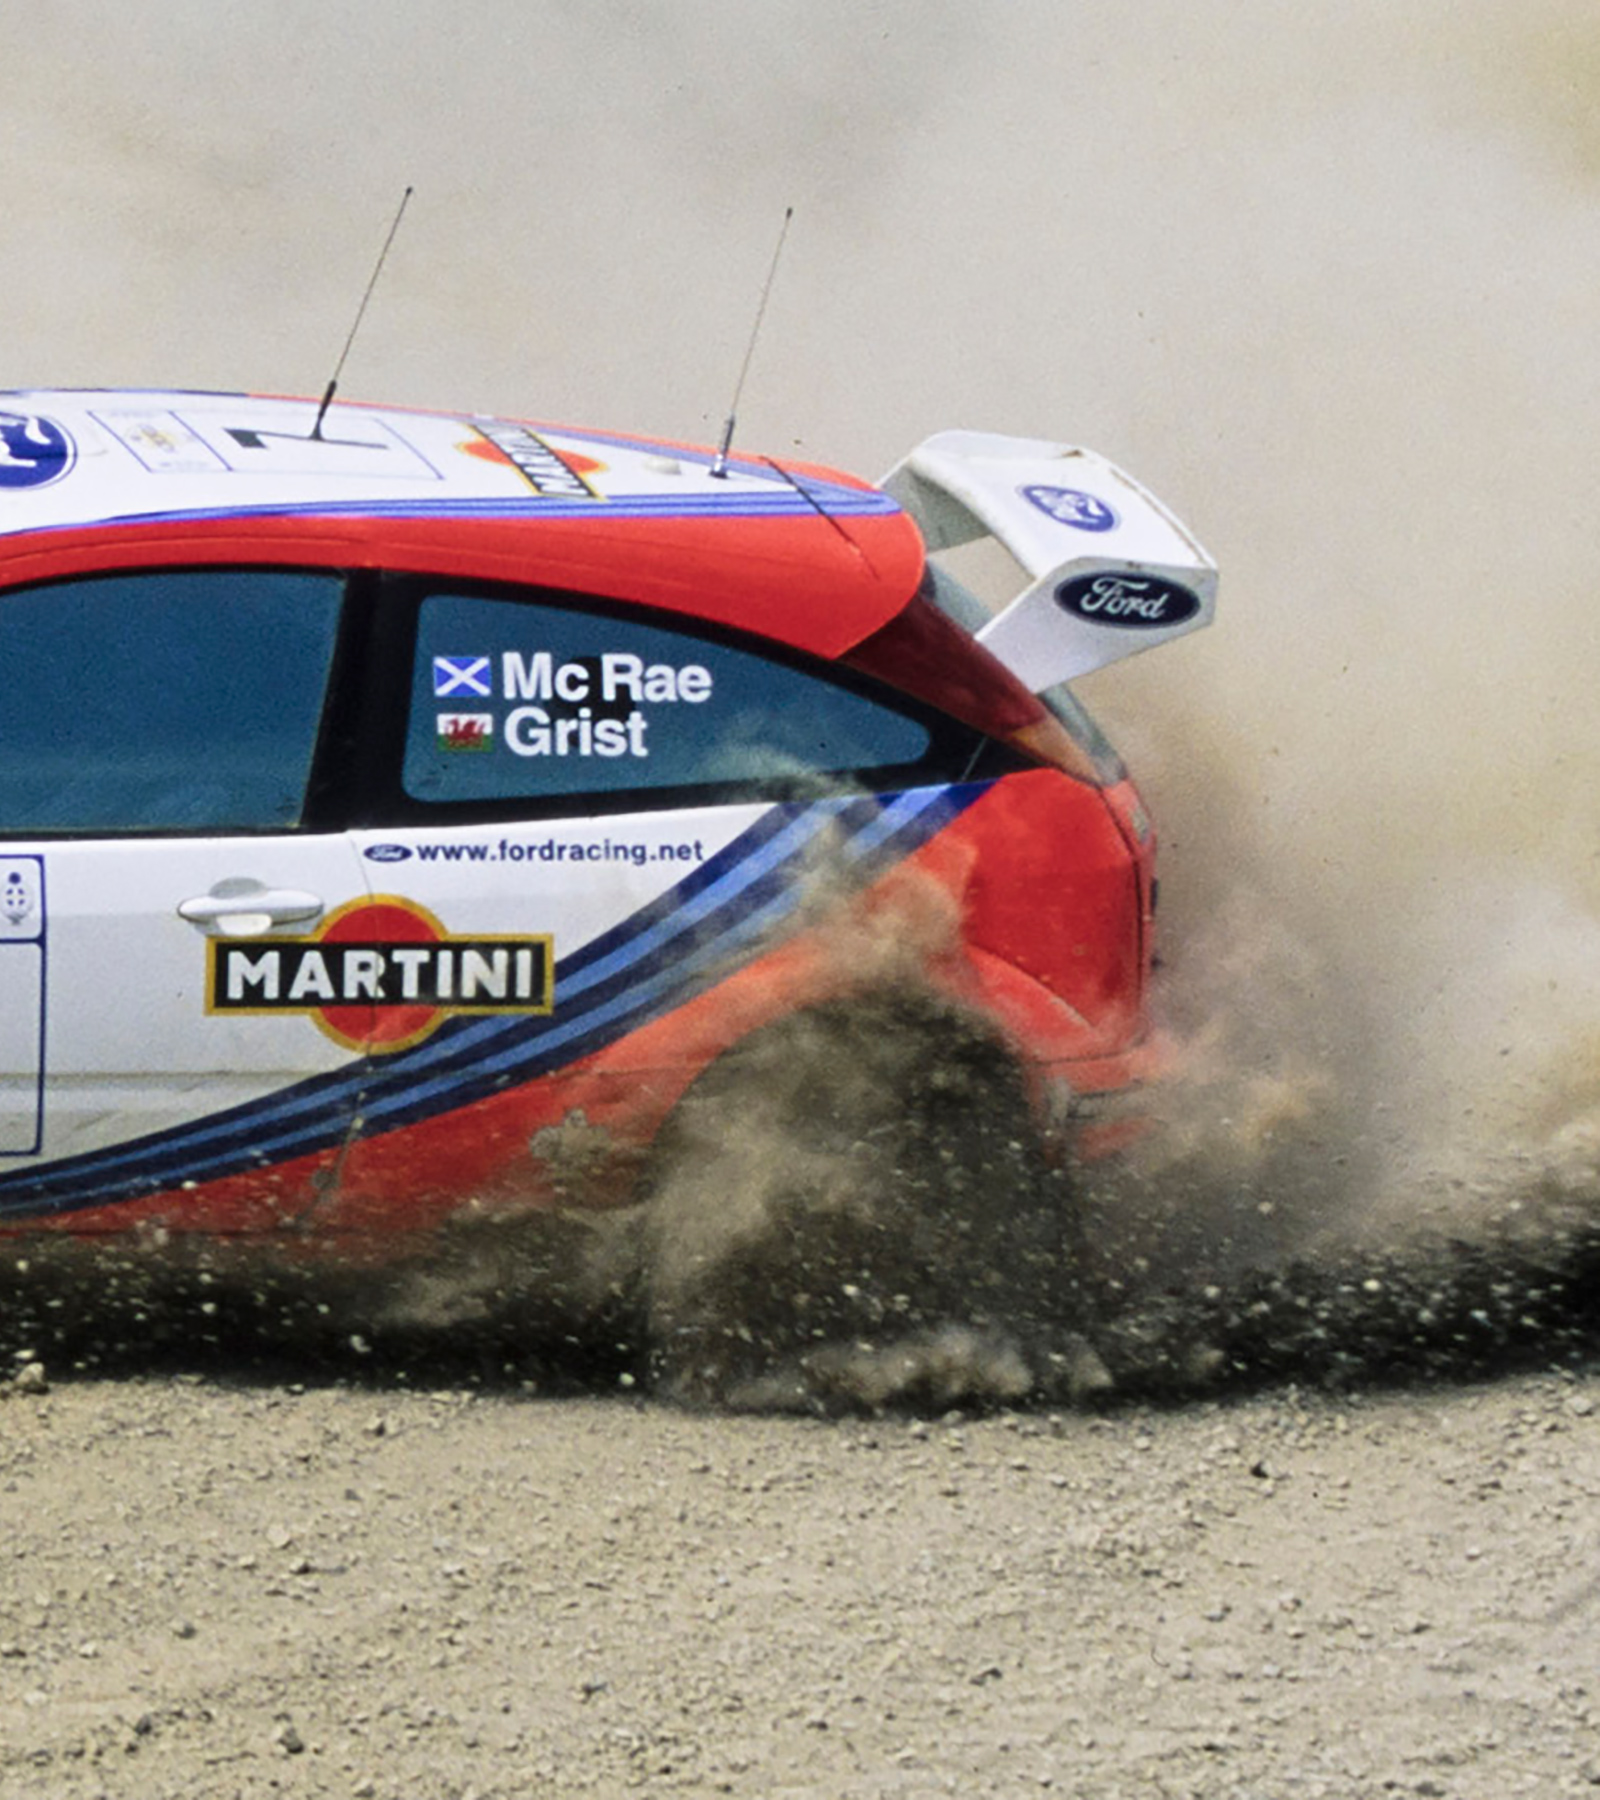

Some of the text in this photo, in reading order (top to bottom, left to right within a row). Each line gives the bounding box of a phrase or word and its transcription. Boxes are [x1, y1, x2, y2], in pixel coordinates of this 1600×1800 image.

[1080, 576, 1169, 619] Ford
[503, 653, 712, 701] Mc Rae
[505, 708, 648, 757] Grist
[417, 839, 704, 866] www.fordracing.net
[227, 949, 532, 1000] MARTINI
